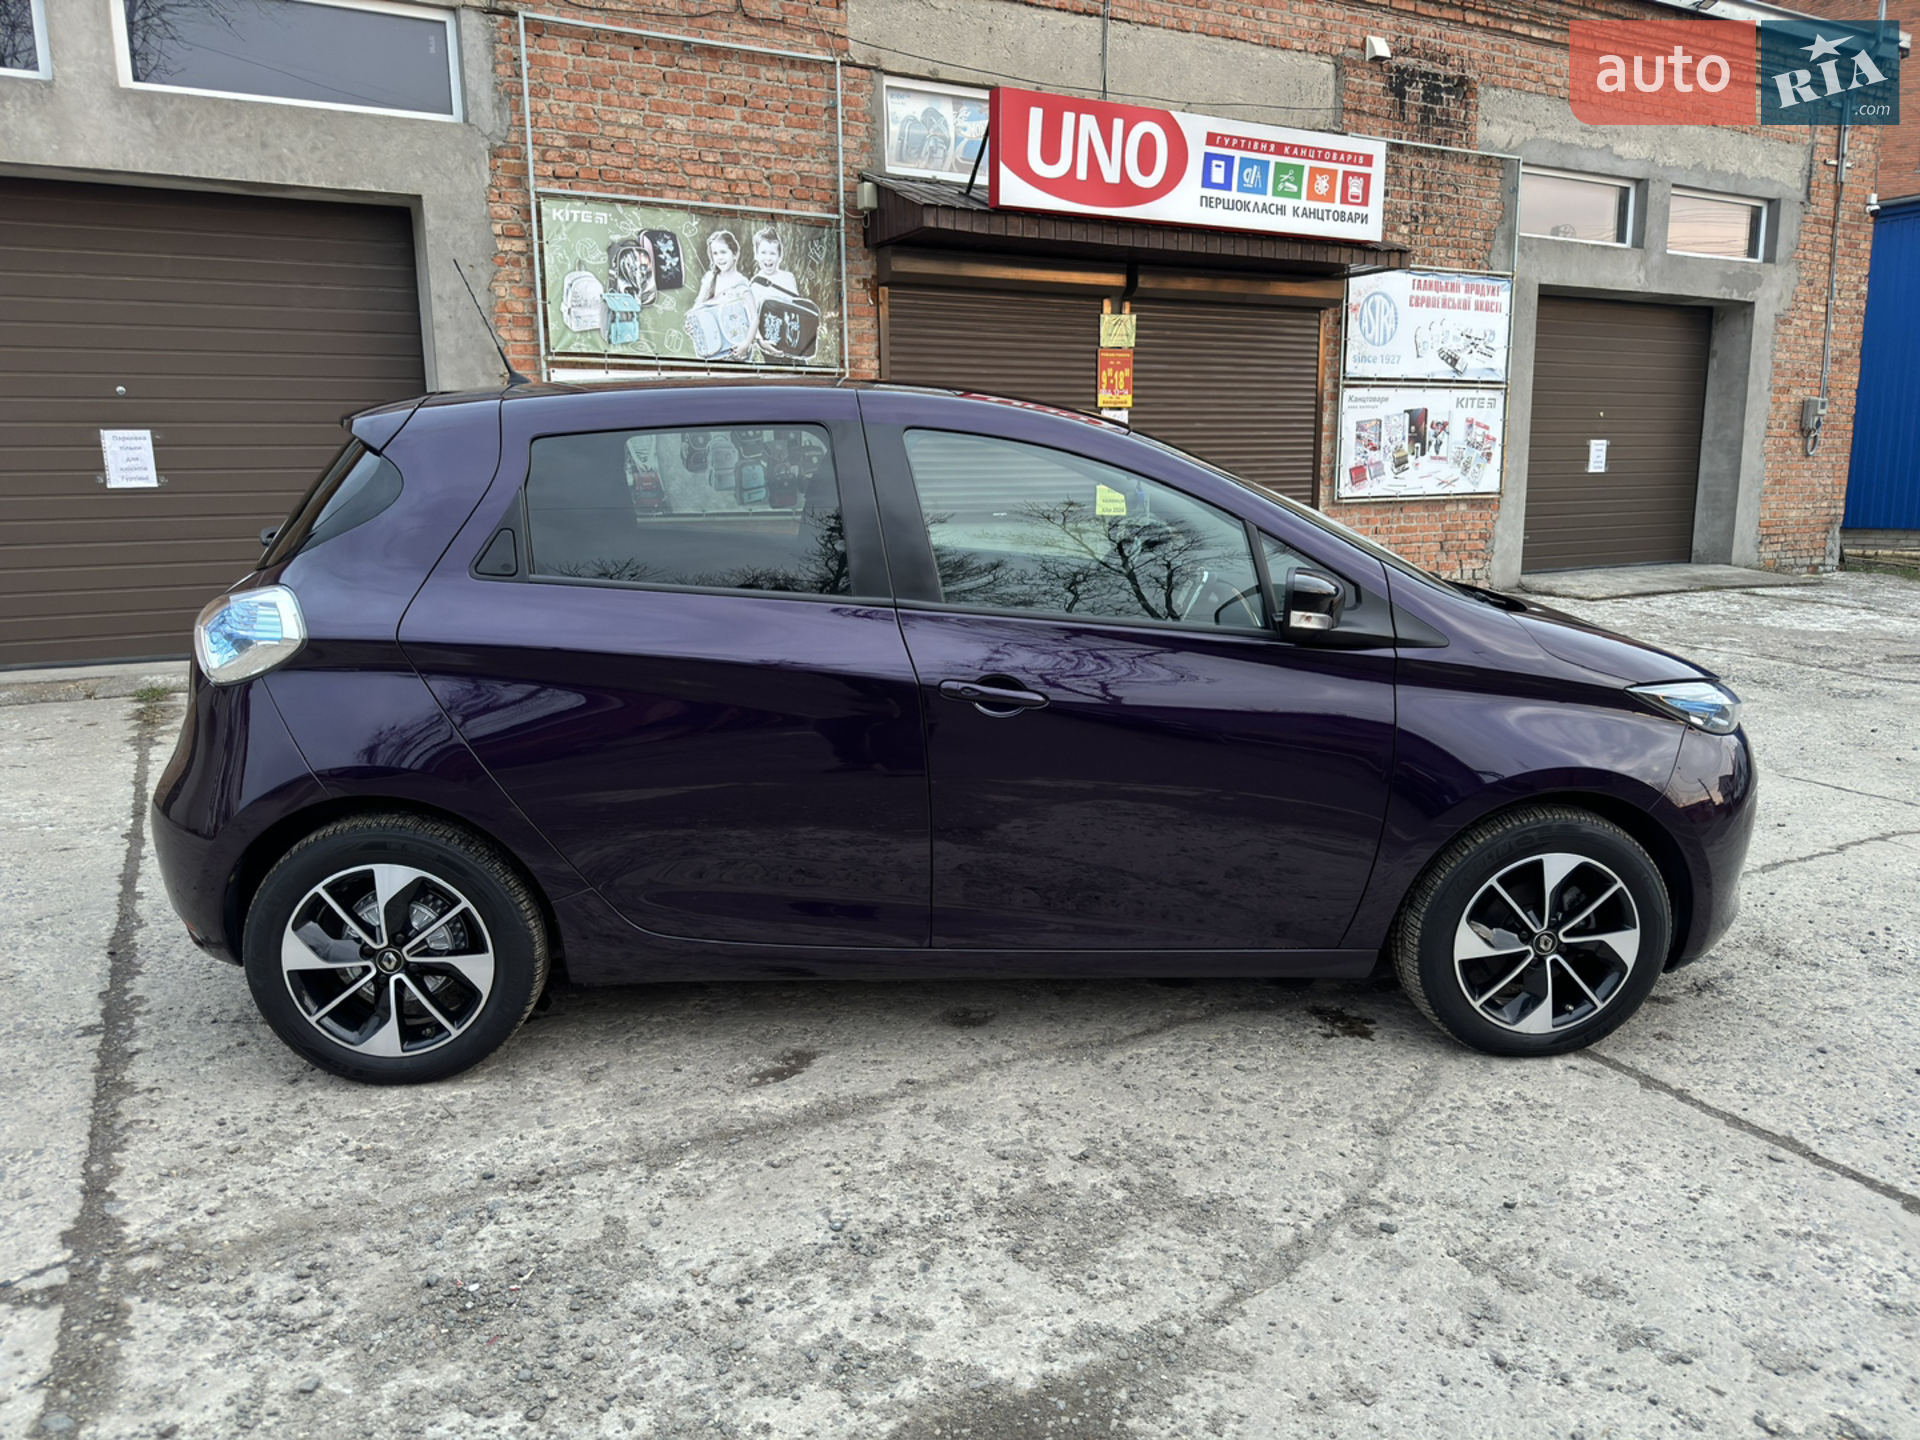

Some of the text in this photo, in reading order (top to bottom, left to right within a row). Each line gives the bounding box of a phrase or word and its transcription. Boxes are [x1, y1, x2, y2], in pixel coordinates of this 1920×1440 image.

[1026, 106, 1169, 189] UNO
[1215, 135, 1365, 165] ГУРТІВНЯ КАНЦТОВАРІВ
[552, 208, 593, 223] KITE
[1199, 195, 1369, 225] ПЕРШОКЛАСНІ КАНЦТОВАРИ
[1352, 352, 1401, 365] since 1927
[1347, 394, 1390, 405] Канцтовари
[1455, 396, 1485, 409] KITE
